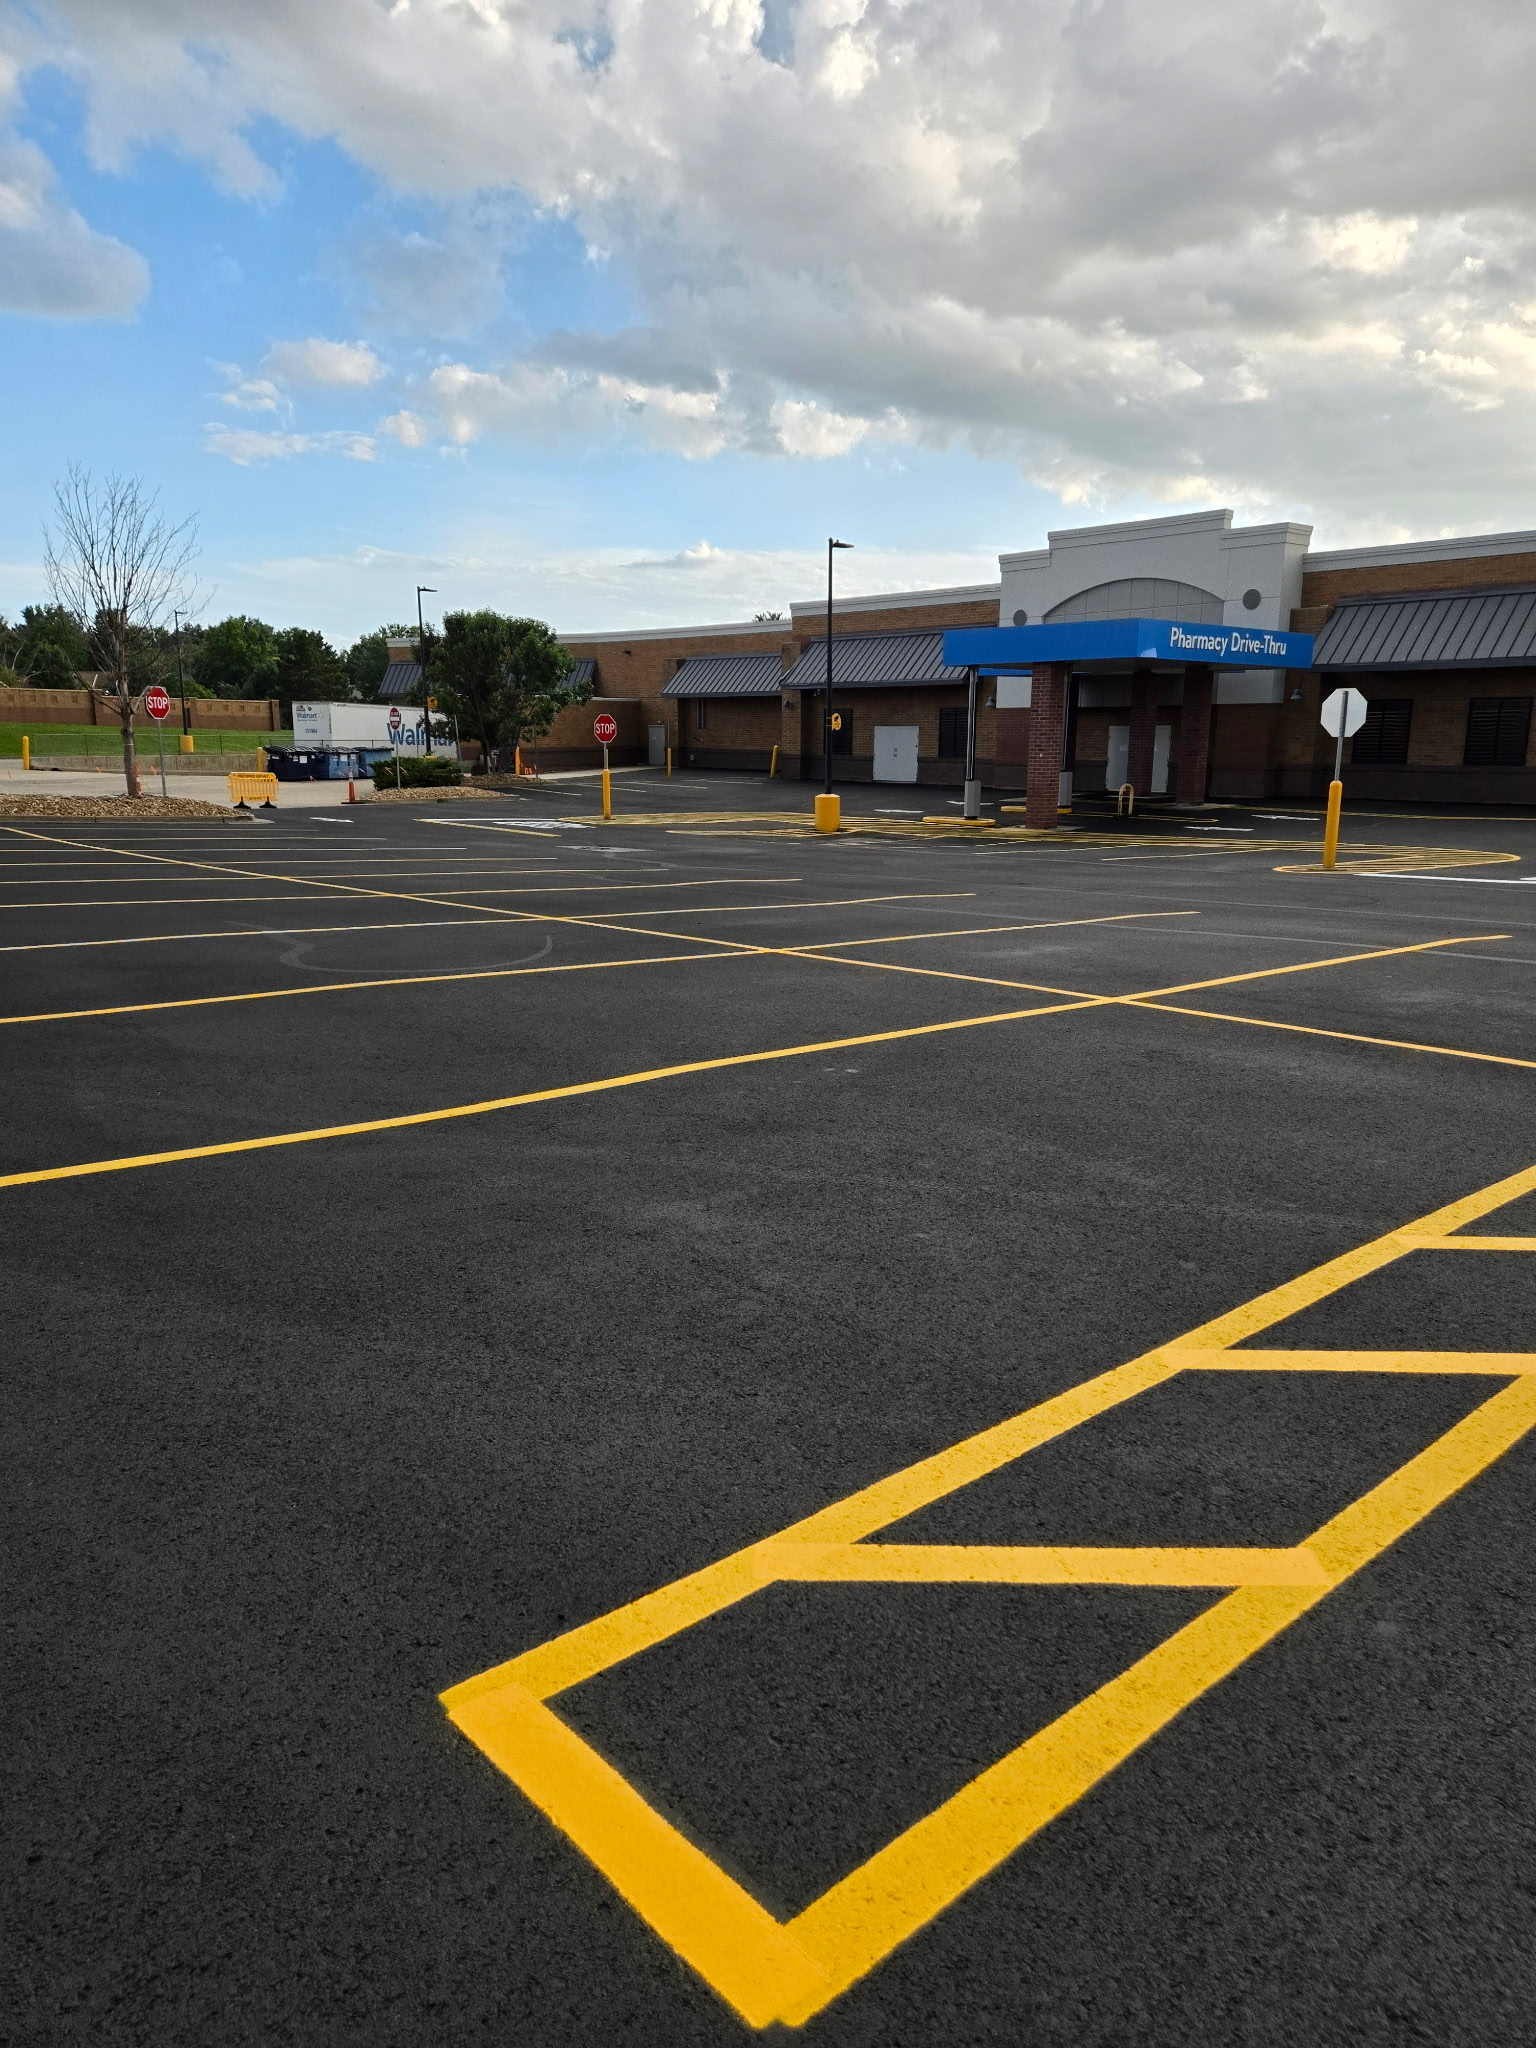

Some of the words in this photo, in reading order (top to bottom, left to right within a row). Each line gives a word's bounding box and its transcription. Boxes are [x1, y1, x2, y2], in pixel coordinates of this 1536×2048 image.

[1170, 627, 1228, 657] Pharmacy
[1231, 632, 1287, 656] Drive-Thru
[148, 696, 168, 709] STOP
[595, 723, 615, 734] STOP
